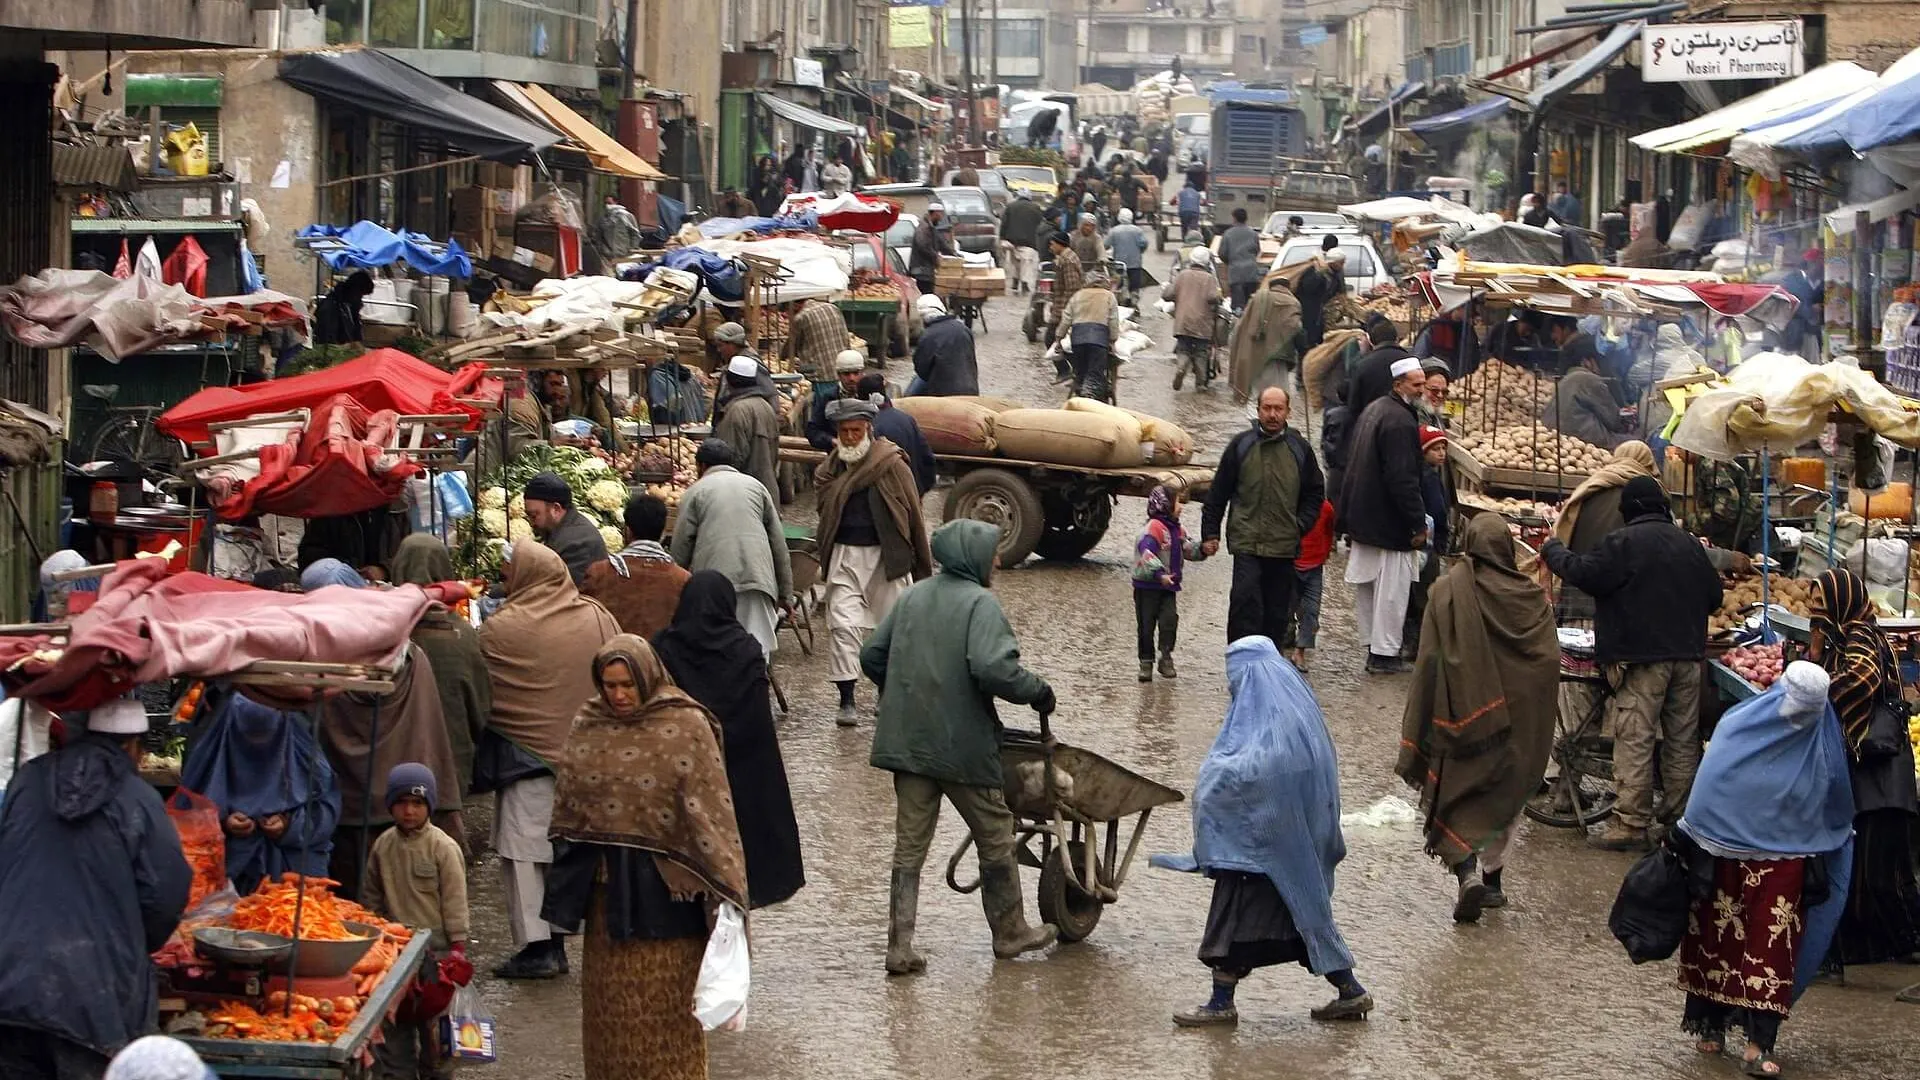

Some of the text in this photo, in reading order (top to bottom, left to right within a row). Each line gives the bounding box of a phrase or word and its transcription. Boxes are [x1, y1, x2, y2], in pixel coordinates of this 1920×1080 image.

[1671, 27, 1796, 56] ناصری درملتون
[1686, 58, 1786, 75] Nasiri Pharmacy
